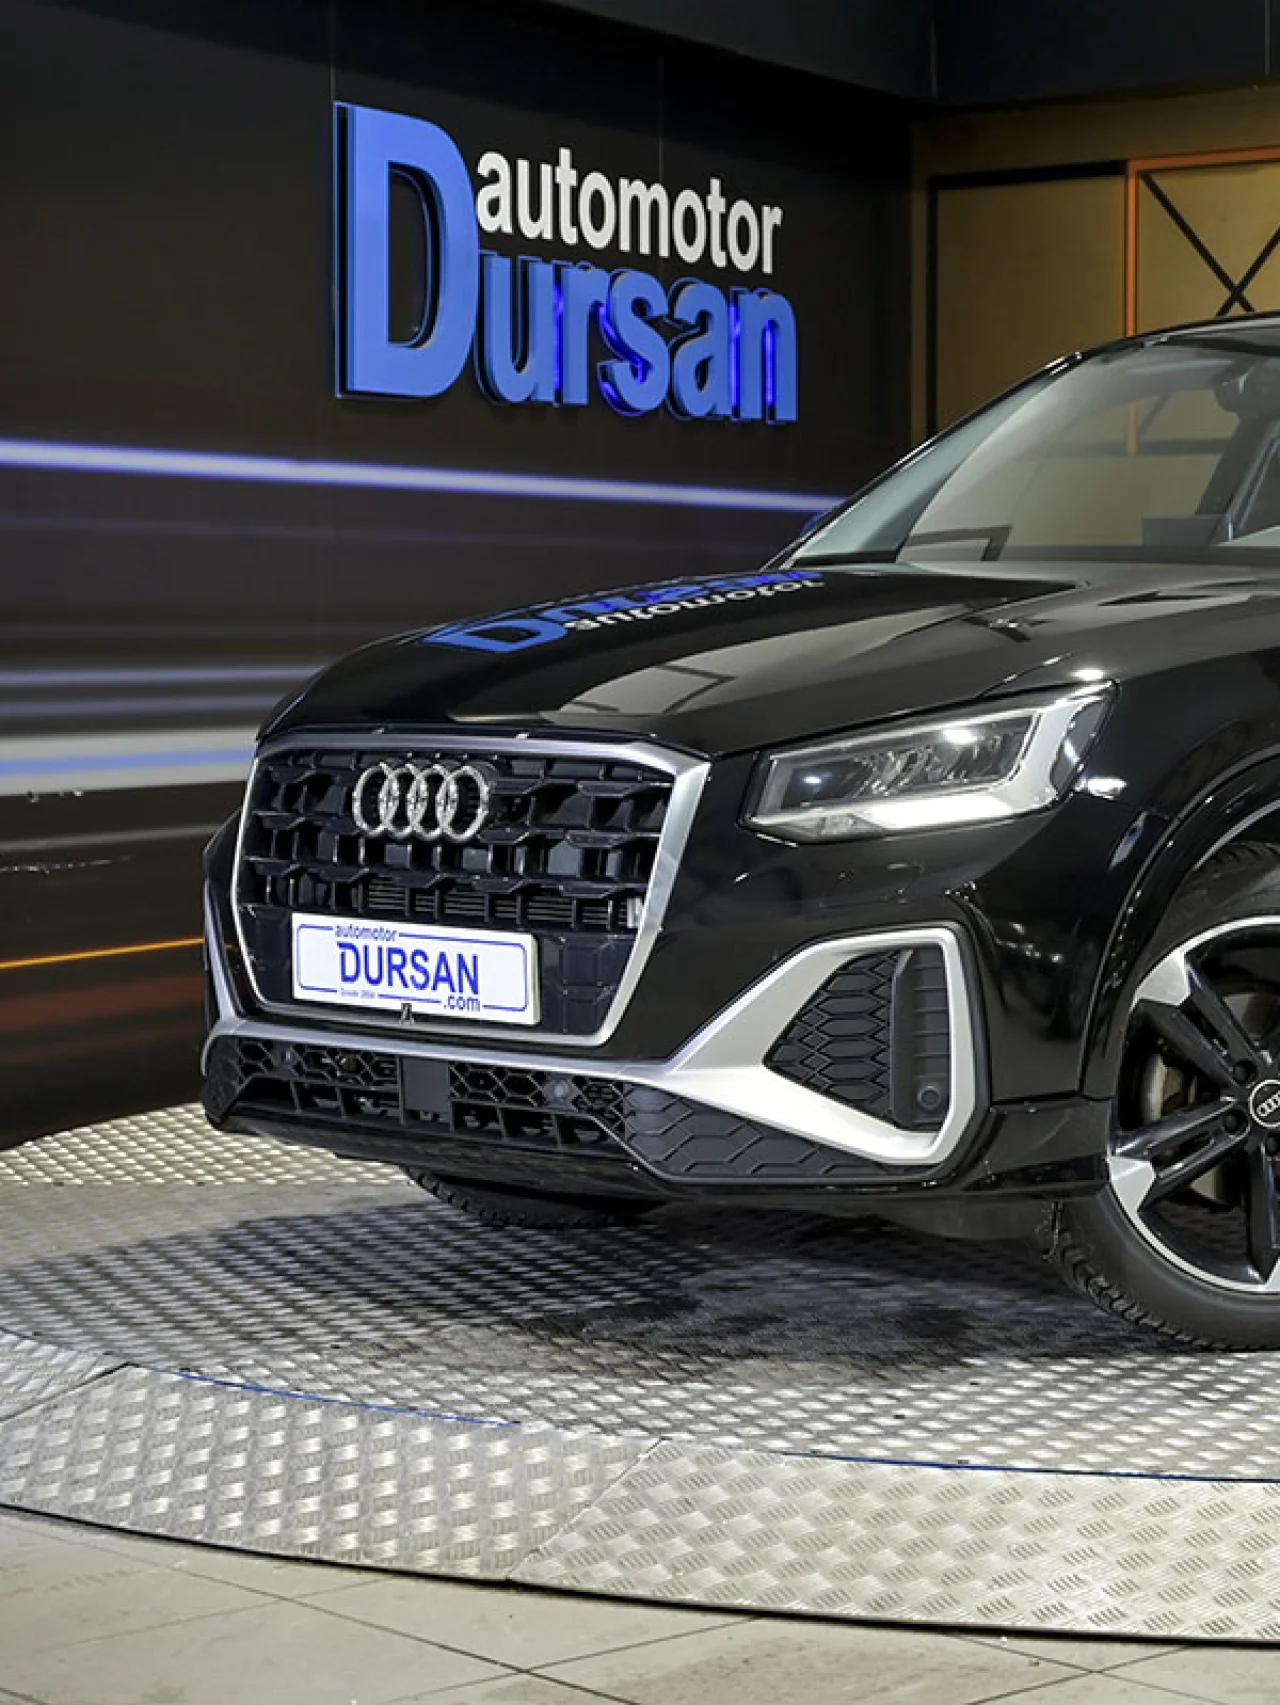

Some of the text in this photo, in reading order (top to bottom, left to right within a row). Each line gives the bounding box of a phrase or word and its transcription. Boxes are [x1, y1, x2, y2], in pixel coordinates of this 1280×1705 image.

[476, 146, 783, 275] automotor
[334, 101, 799, 423] Dursan
[334, 923, 397, 942] automotor
[337, 941, 479, 995] DURSAN
[443, 995, 481, 1012] .com
